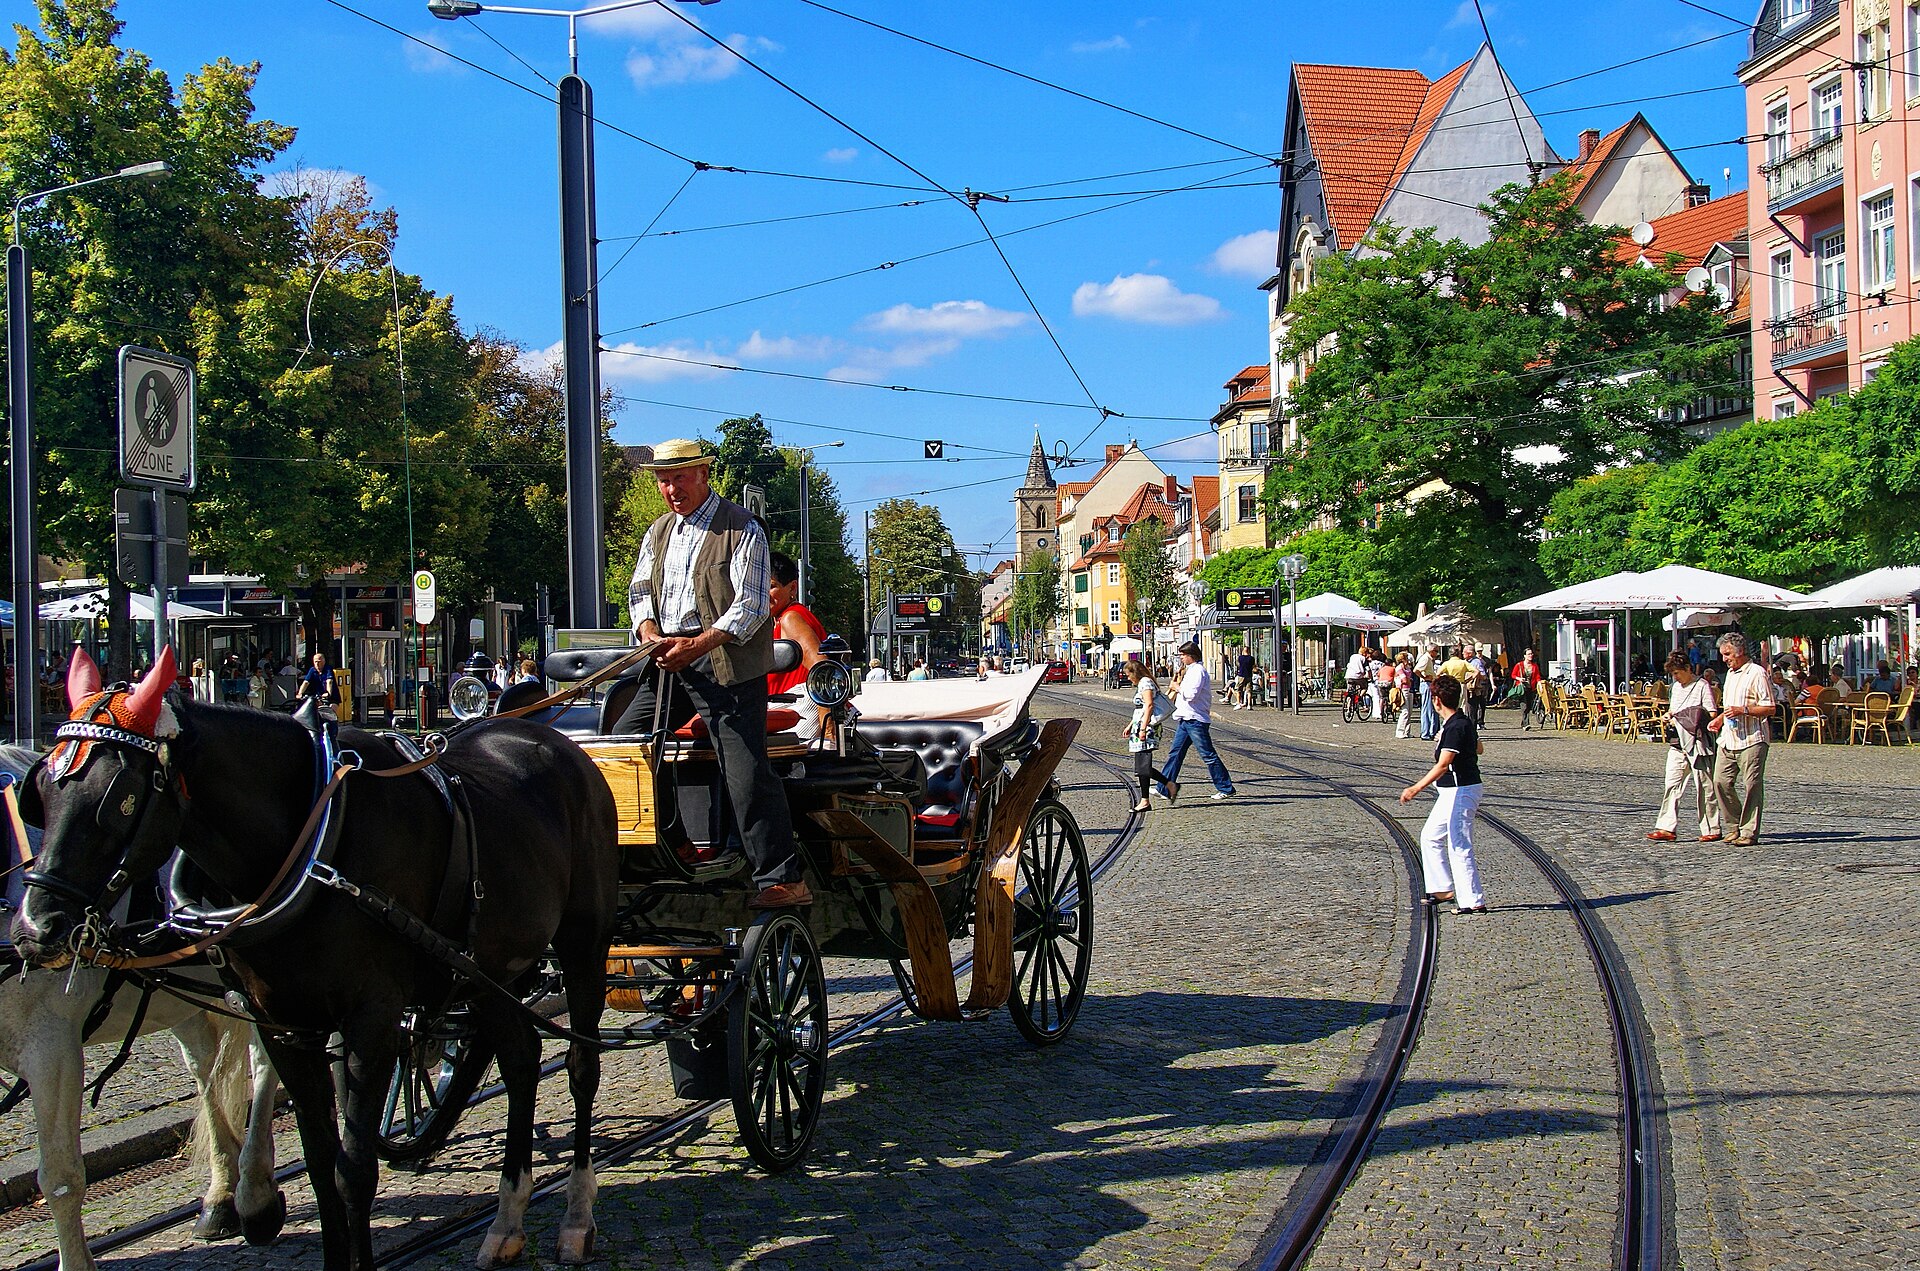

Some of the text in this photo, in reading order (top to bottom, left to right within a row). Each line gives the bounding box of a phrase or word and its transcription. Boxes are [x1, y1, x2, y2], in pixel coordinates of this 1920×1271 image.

[142, 452, 173, 473] ZONE
[420, 577, 428, 587] H
[1230, 594, 1237, 603] H
[931, 601, 938, 609] H
